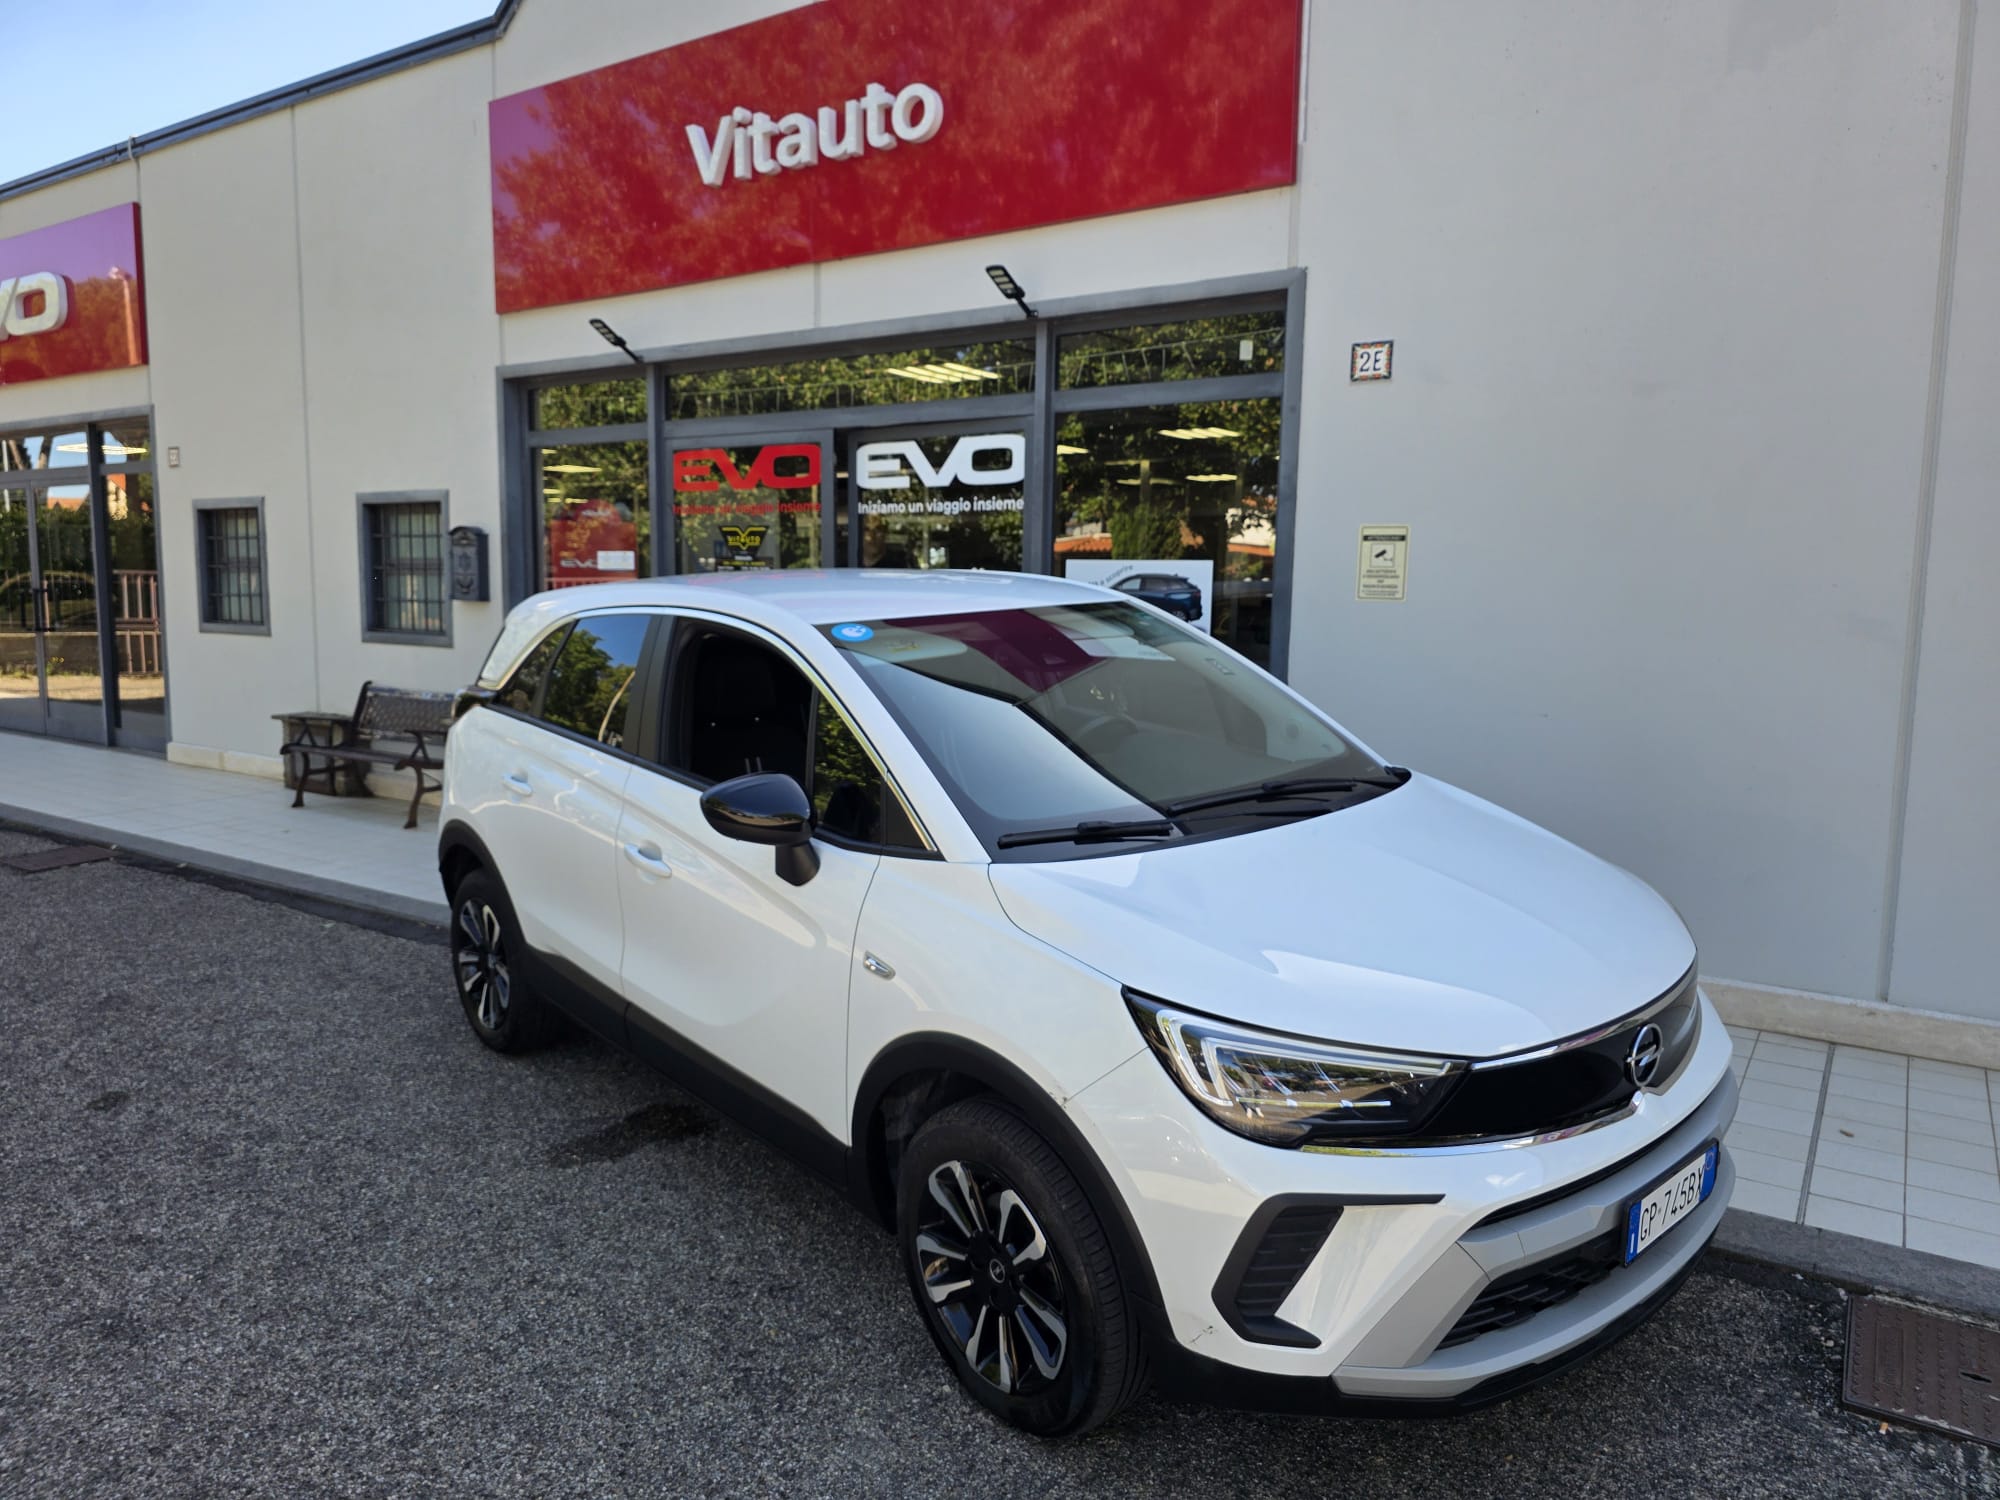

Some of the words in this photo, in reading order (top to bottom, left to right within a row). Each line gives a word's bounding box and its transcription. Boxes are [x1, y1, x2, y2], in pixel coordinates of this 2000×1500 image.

[685, 82, 944, 188] Vitauto
[1359, 350, 1384, 372] 2E
[673, 443, 821, 491] EVO
[856, 433, 1026, 490] EVO
[777, 500, 822, 513] insieme
[857, 500, 906, 515] Iniziamo
[908, 501, 925, 513] un
[926, 497, 972, 515] viaggio
[973, 495, 1025, 512] insieme
[560, 559, 598, 569] EV
[1640, 1201, 1658, 1241] GP
[1662, 1166, 1705, 1225] 745BX
